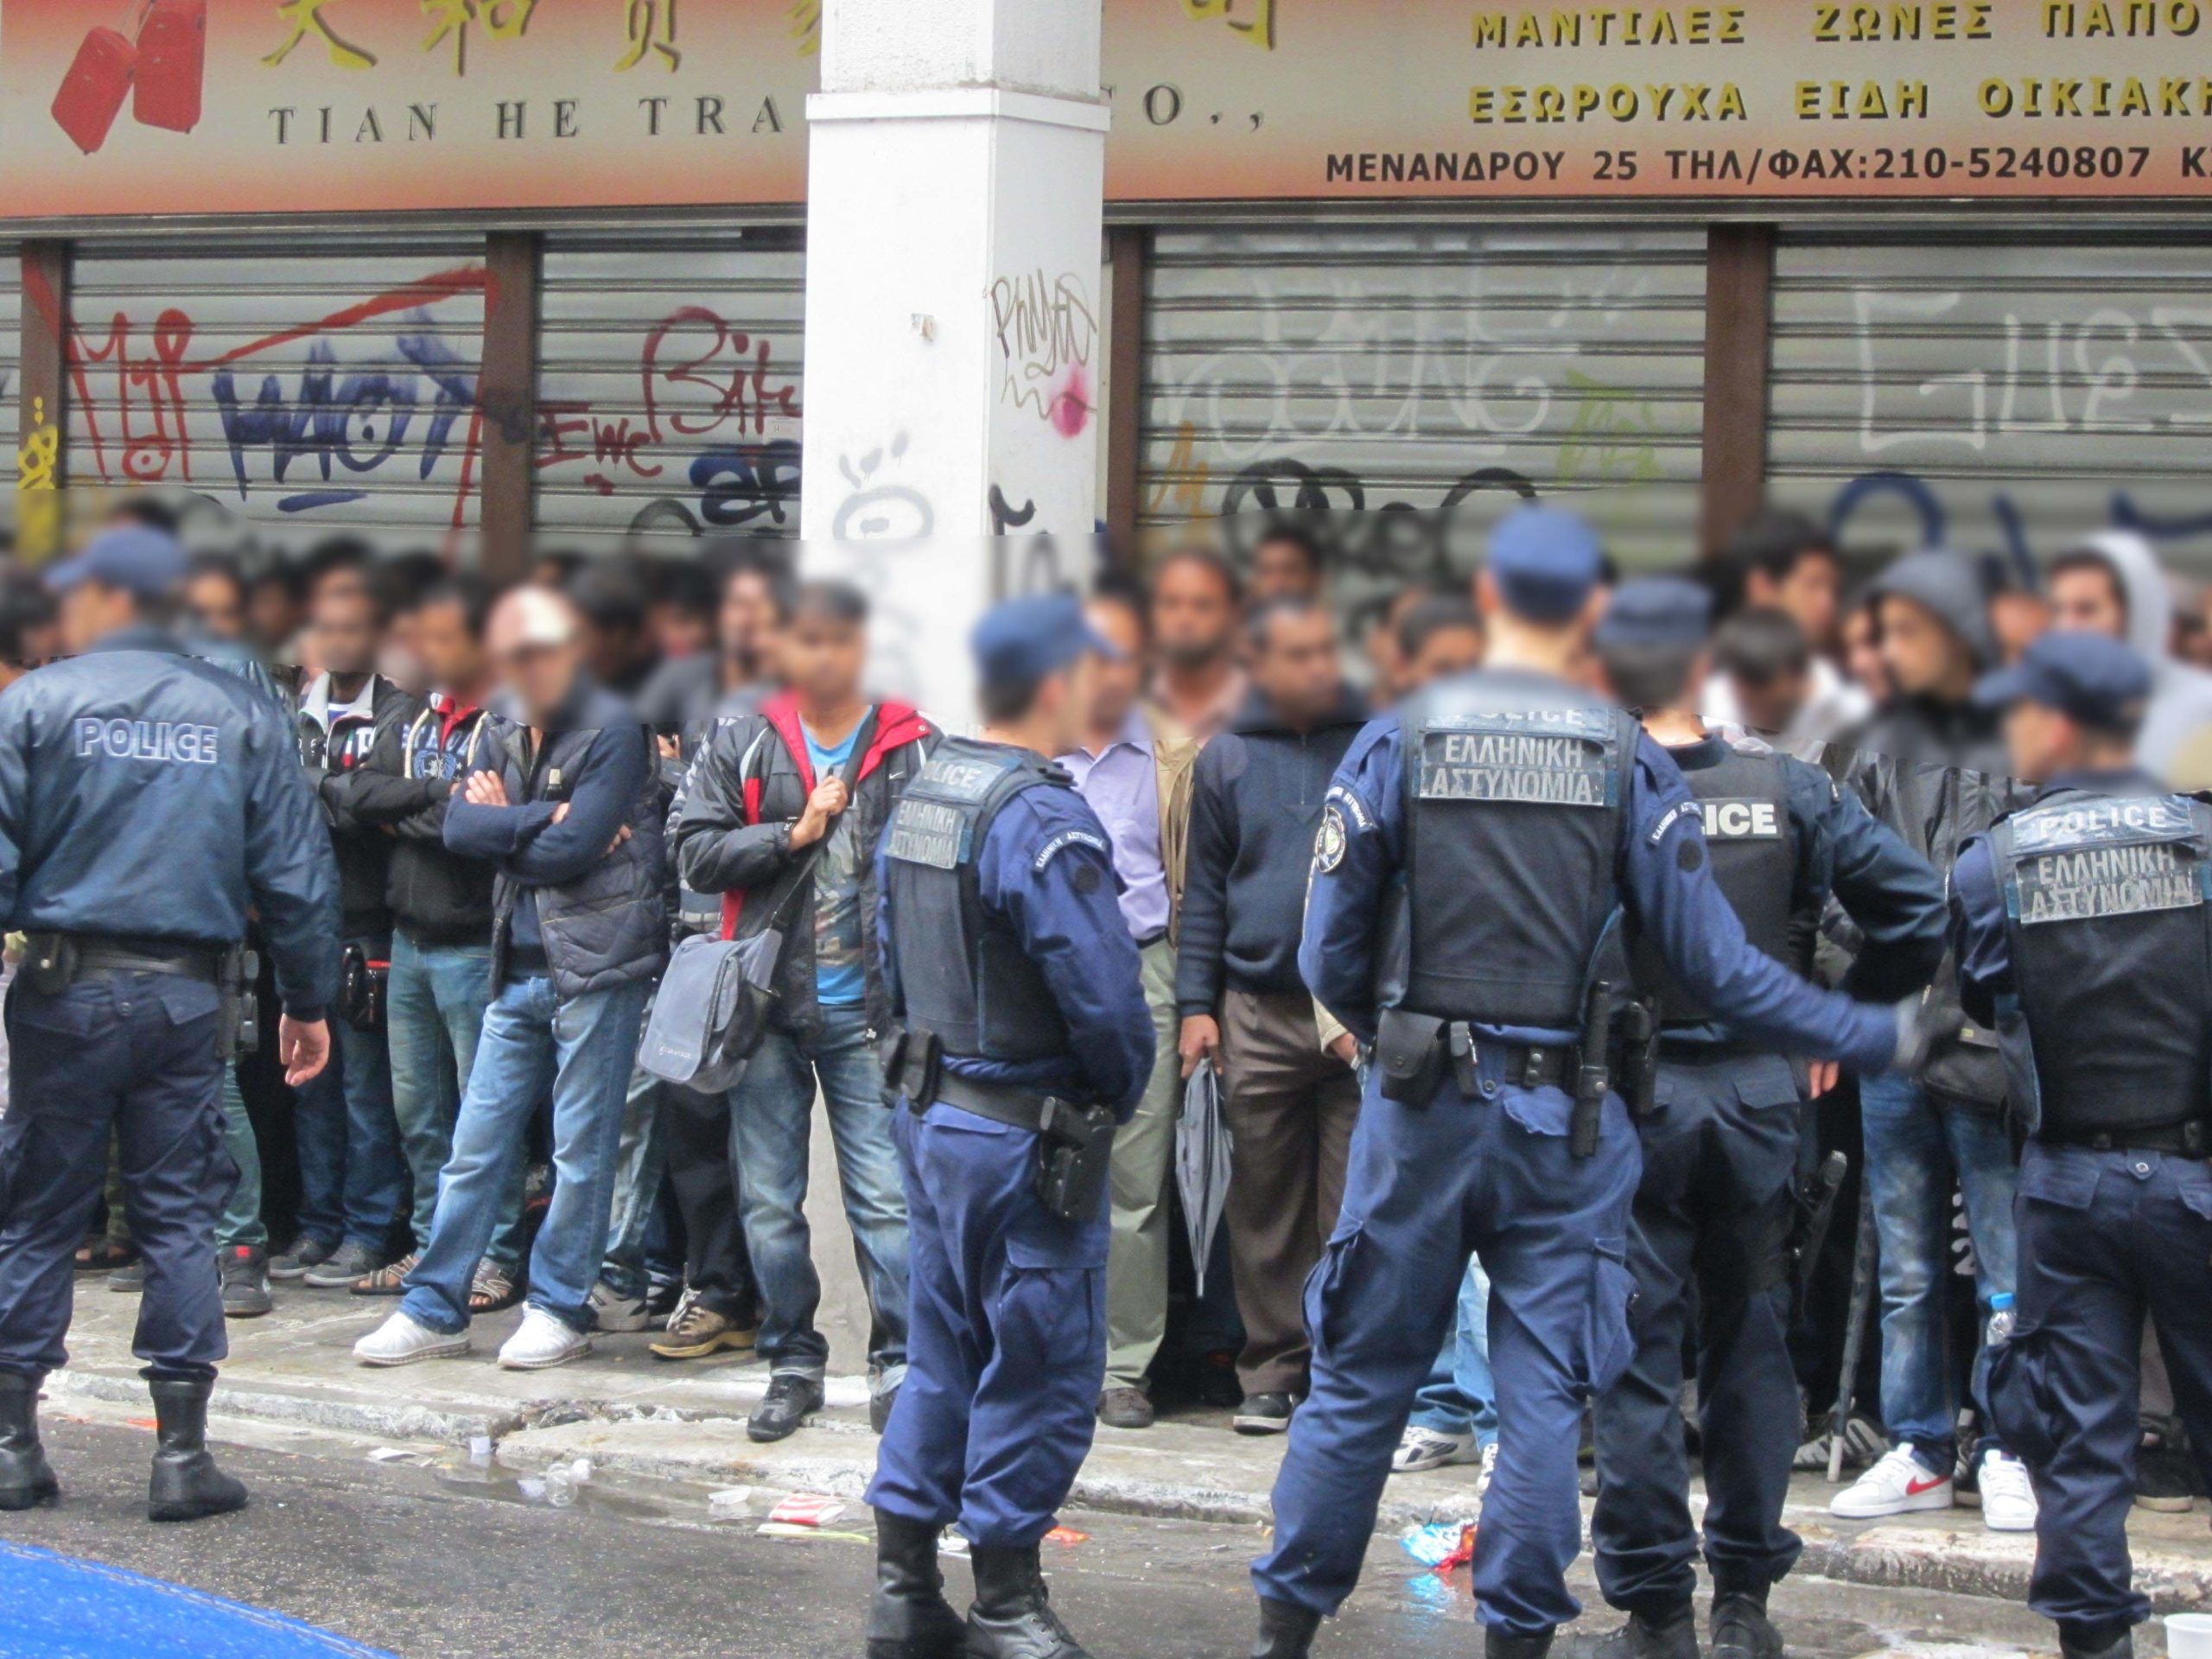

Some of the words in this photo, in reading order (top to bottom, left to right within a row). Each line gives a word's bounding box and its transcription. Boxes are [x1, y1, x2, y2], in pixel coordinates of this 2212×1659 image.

[1471, 6, 1745, 48] ΜΑΝΤΙΛΕΣ
[1811, 3, 1993, 42] ΖΩΝΕΣ
[2040, 0, 2212, 38] ΠΑΠΟ
[268, 103, 438, 145] TIAN
[495, 97, 581, 140] HE
[1469, 82, 1748, 124] ΕΣΩΡΟΥΧΑ
[1794, 79, 1928, 120] ΕΙΔΗ
[1326, 150, 1566, 183] ΜΕΝΑΝΔΡΟΥ
[1592, 150, 1638, 181] 25
[2181, 145, 2212, 179] Κ
[74, 717, 219, 764] POLICE
[1445, 734, 1584, 768] ΕΛΛΗΝΙΚΗ
[1430, 767, 1593, 804] ΑΣΤΥΝΟΜΙΑ
[1700, 804, 1777, 836] ICE
[2039, 805, 2168, 839] POLICE
[2037, 843, 2176, 886] ΕΛΛΗΝΙΚΗ
